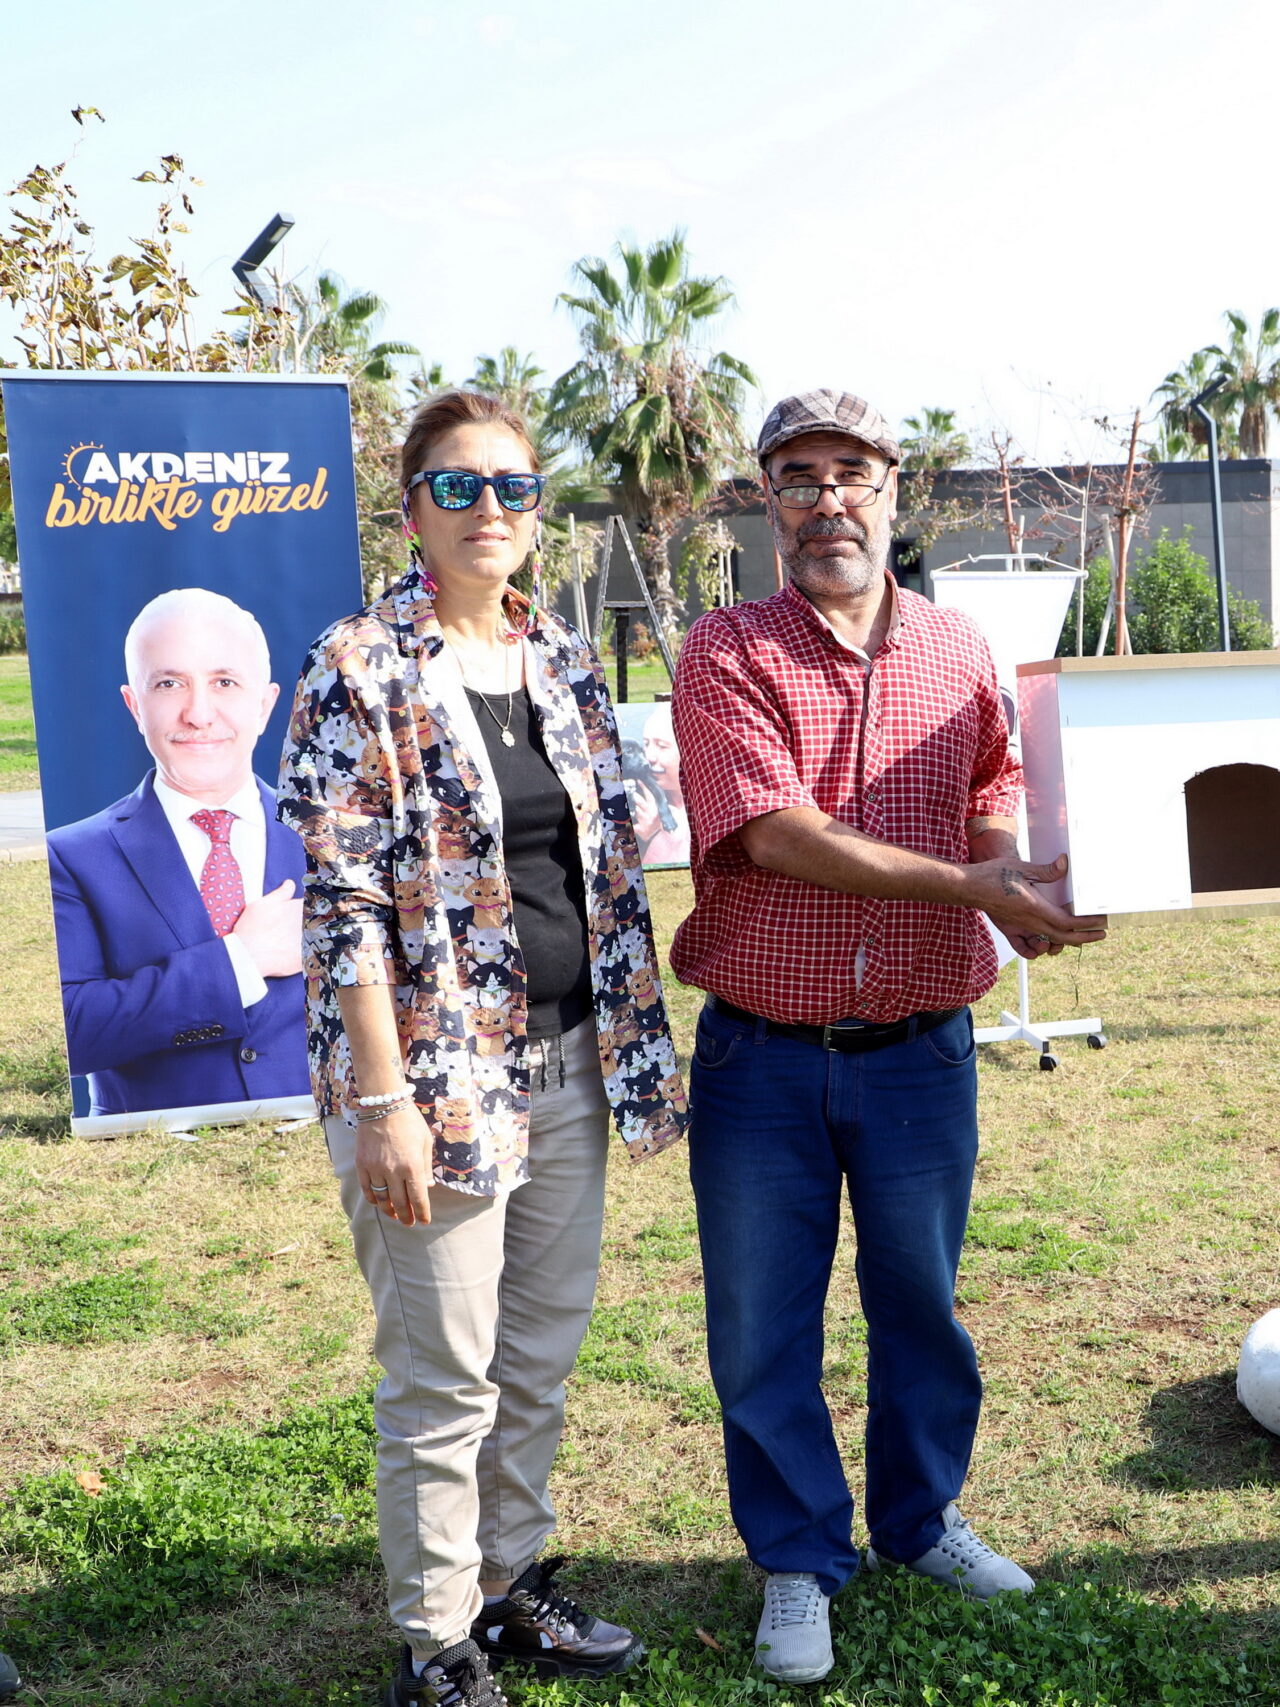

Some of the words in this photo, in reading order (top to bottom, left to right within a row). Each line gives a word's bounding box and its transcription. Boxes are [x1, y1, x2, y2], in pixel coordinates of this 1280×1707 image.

[83, 451, 291, 483] AKDENİZ
[45, 477, 202, 531] birlikte
[211, 467, 328, 532] güzel
